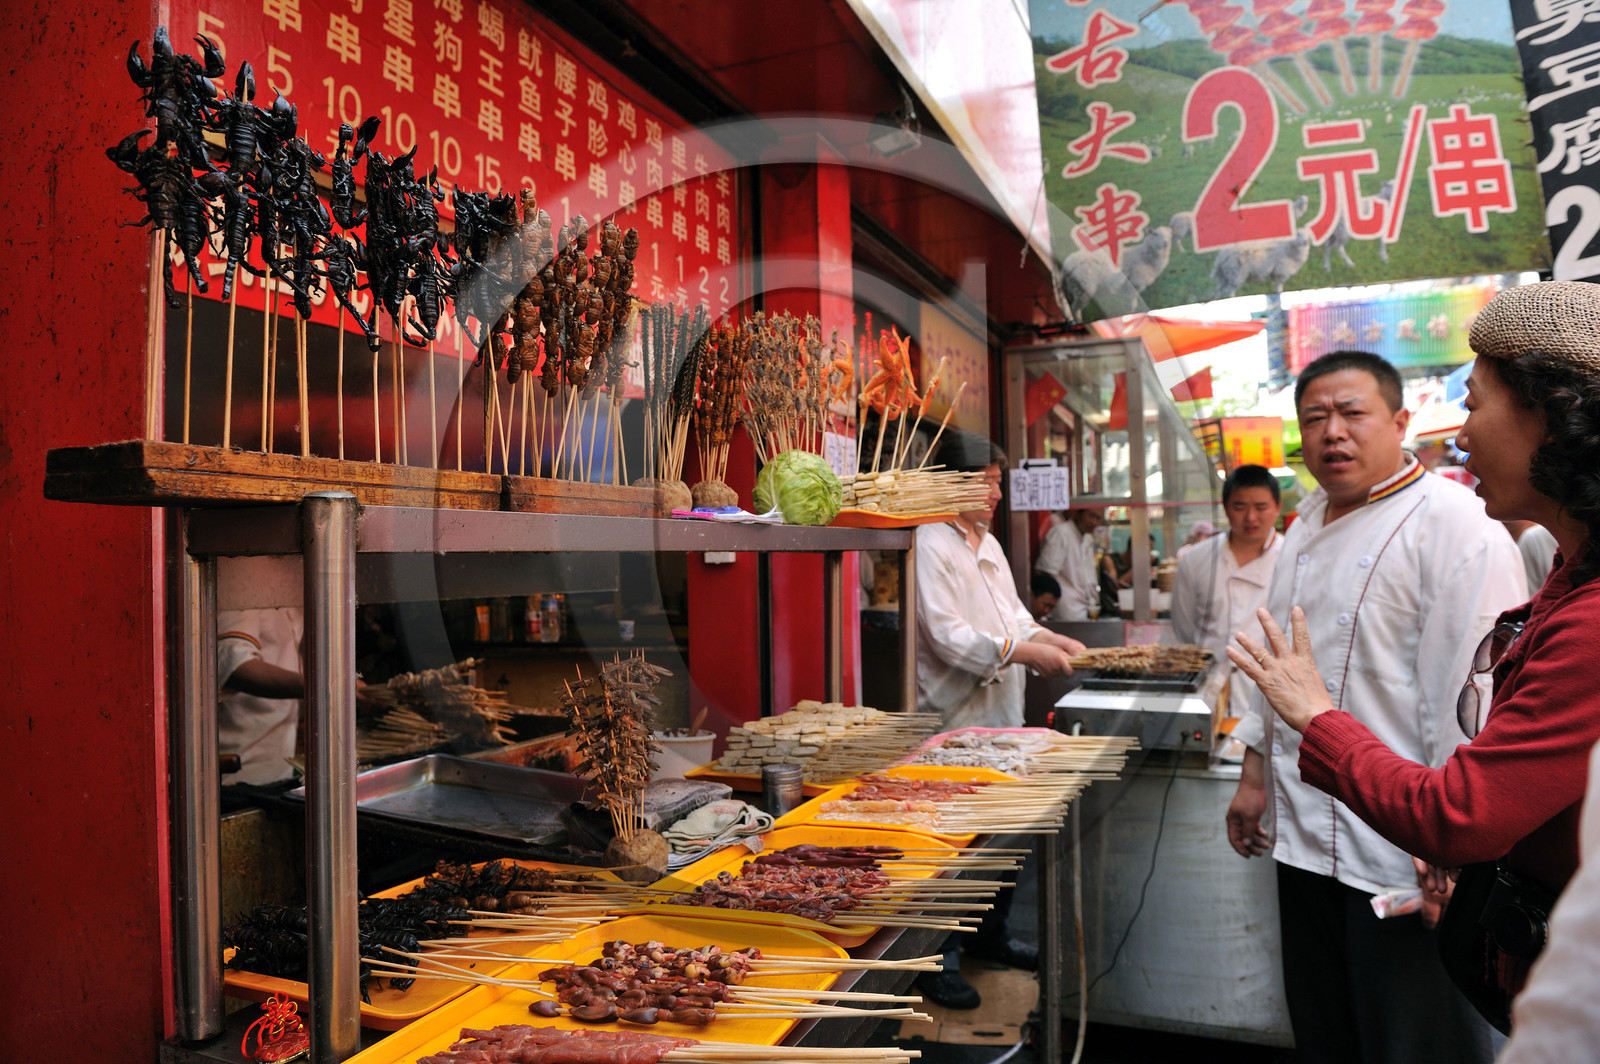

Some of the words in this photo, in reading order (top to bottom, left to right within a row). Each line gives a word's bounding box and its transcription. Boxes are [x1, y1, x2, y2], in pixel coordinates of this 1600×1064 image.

[327, 0, 362, 64] 串
[518, 27, 543, 163] 鱿鱼串
[554, 53, 577, 182] 腰子串
[1046, 0, 1151, 268] 古大串
[617, 100, 638, 215] 鸡心串
[645, 119, 664, 230] 鸡肉串
[671, 135, 688, 243] 里脊串
[694, 153, 711, 255] 牛肉串
[715, 167, 731, 266] 羊肉串
